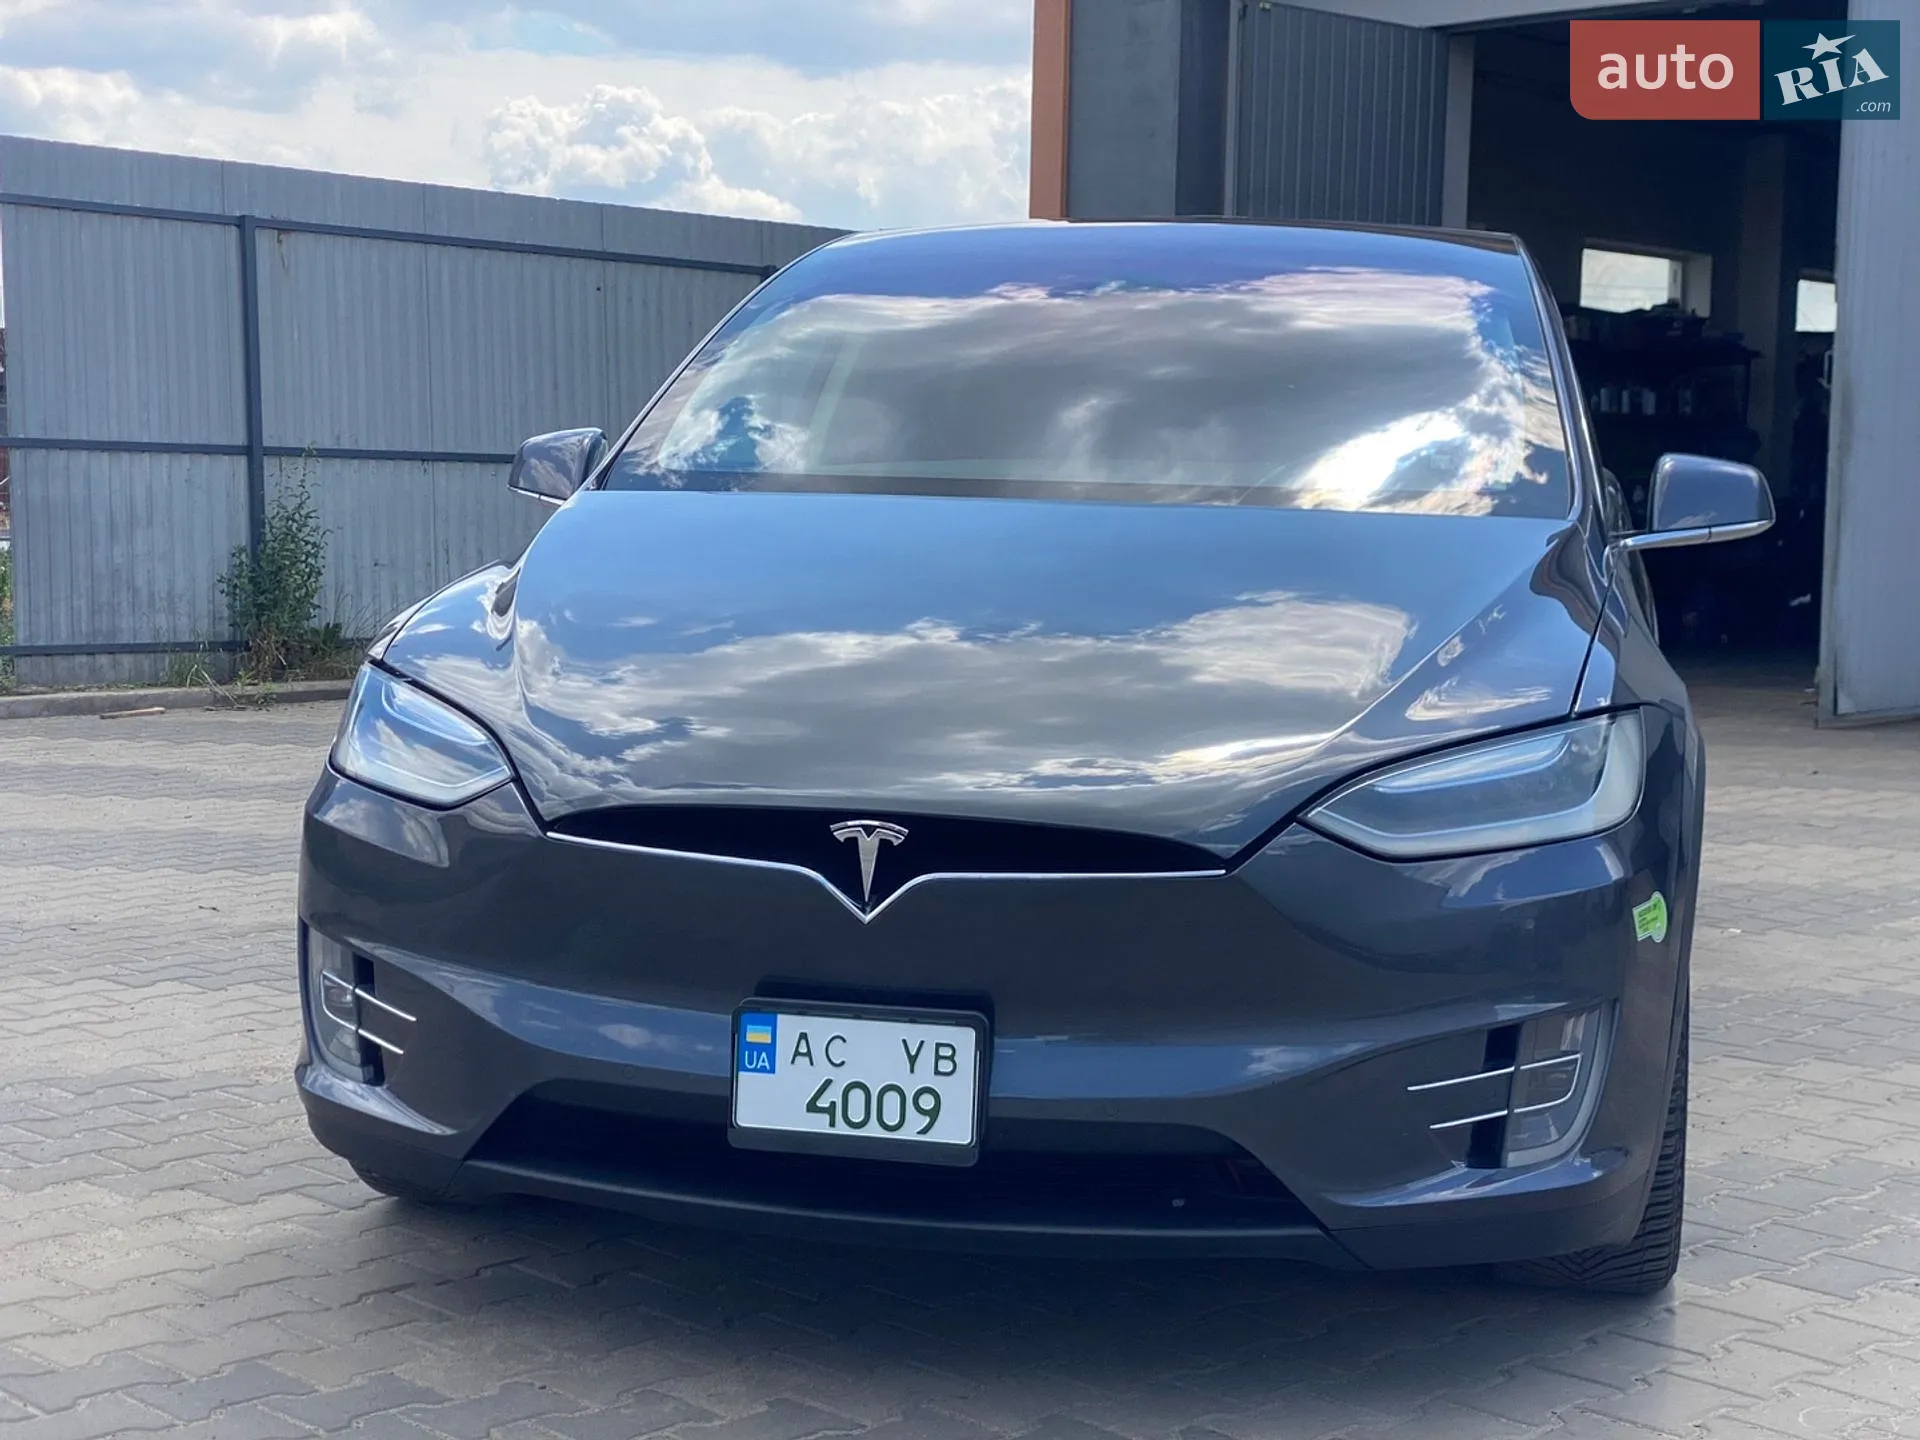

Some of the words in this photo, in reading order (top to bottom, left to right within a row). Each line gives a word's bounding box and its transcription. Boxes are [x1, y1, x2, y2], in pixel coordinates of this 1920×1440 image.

[744, 1051, 770, 1070] UA
[790, 1031, 847, 1068] AC
[901, 1038, 958, 1077] YB
[805, 1077, 942, 1135] 4009
